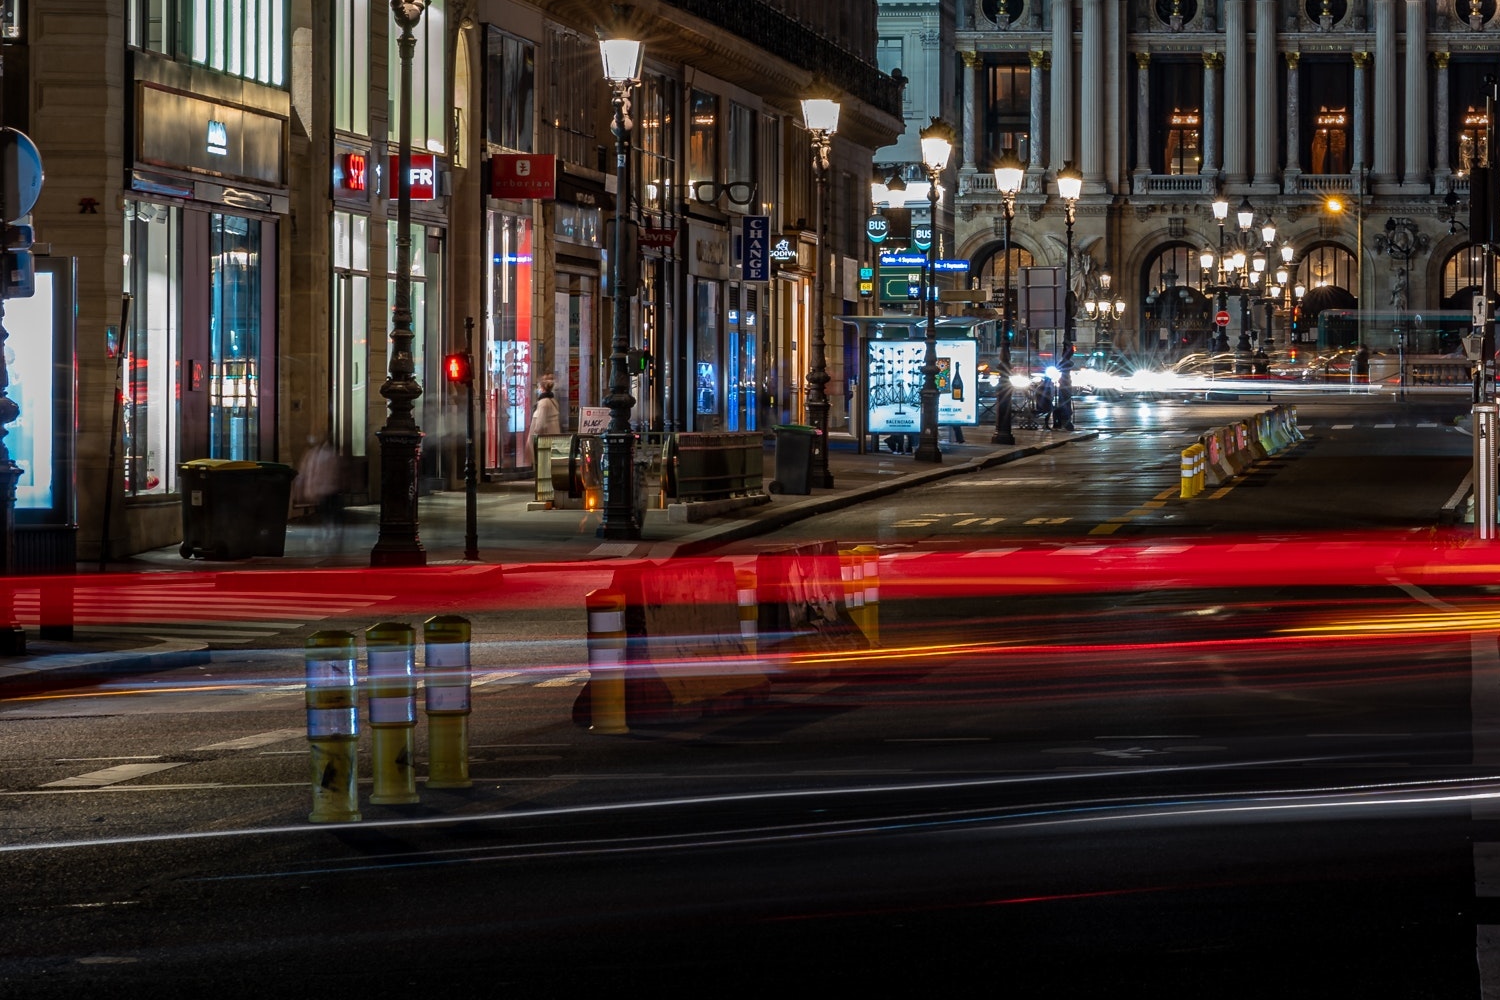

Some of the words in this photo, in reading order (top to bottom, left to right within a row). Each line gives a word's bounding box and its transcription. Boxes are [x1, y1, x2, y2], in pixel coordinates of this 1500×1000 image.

[409, 168, 432, 185] FR
[869, 221, 886, 230] BUS
[916, 230, 931, 239] BUS
[749, 220, 763, 278] CHANGE
[583, 419, 604, 428] BLACK
